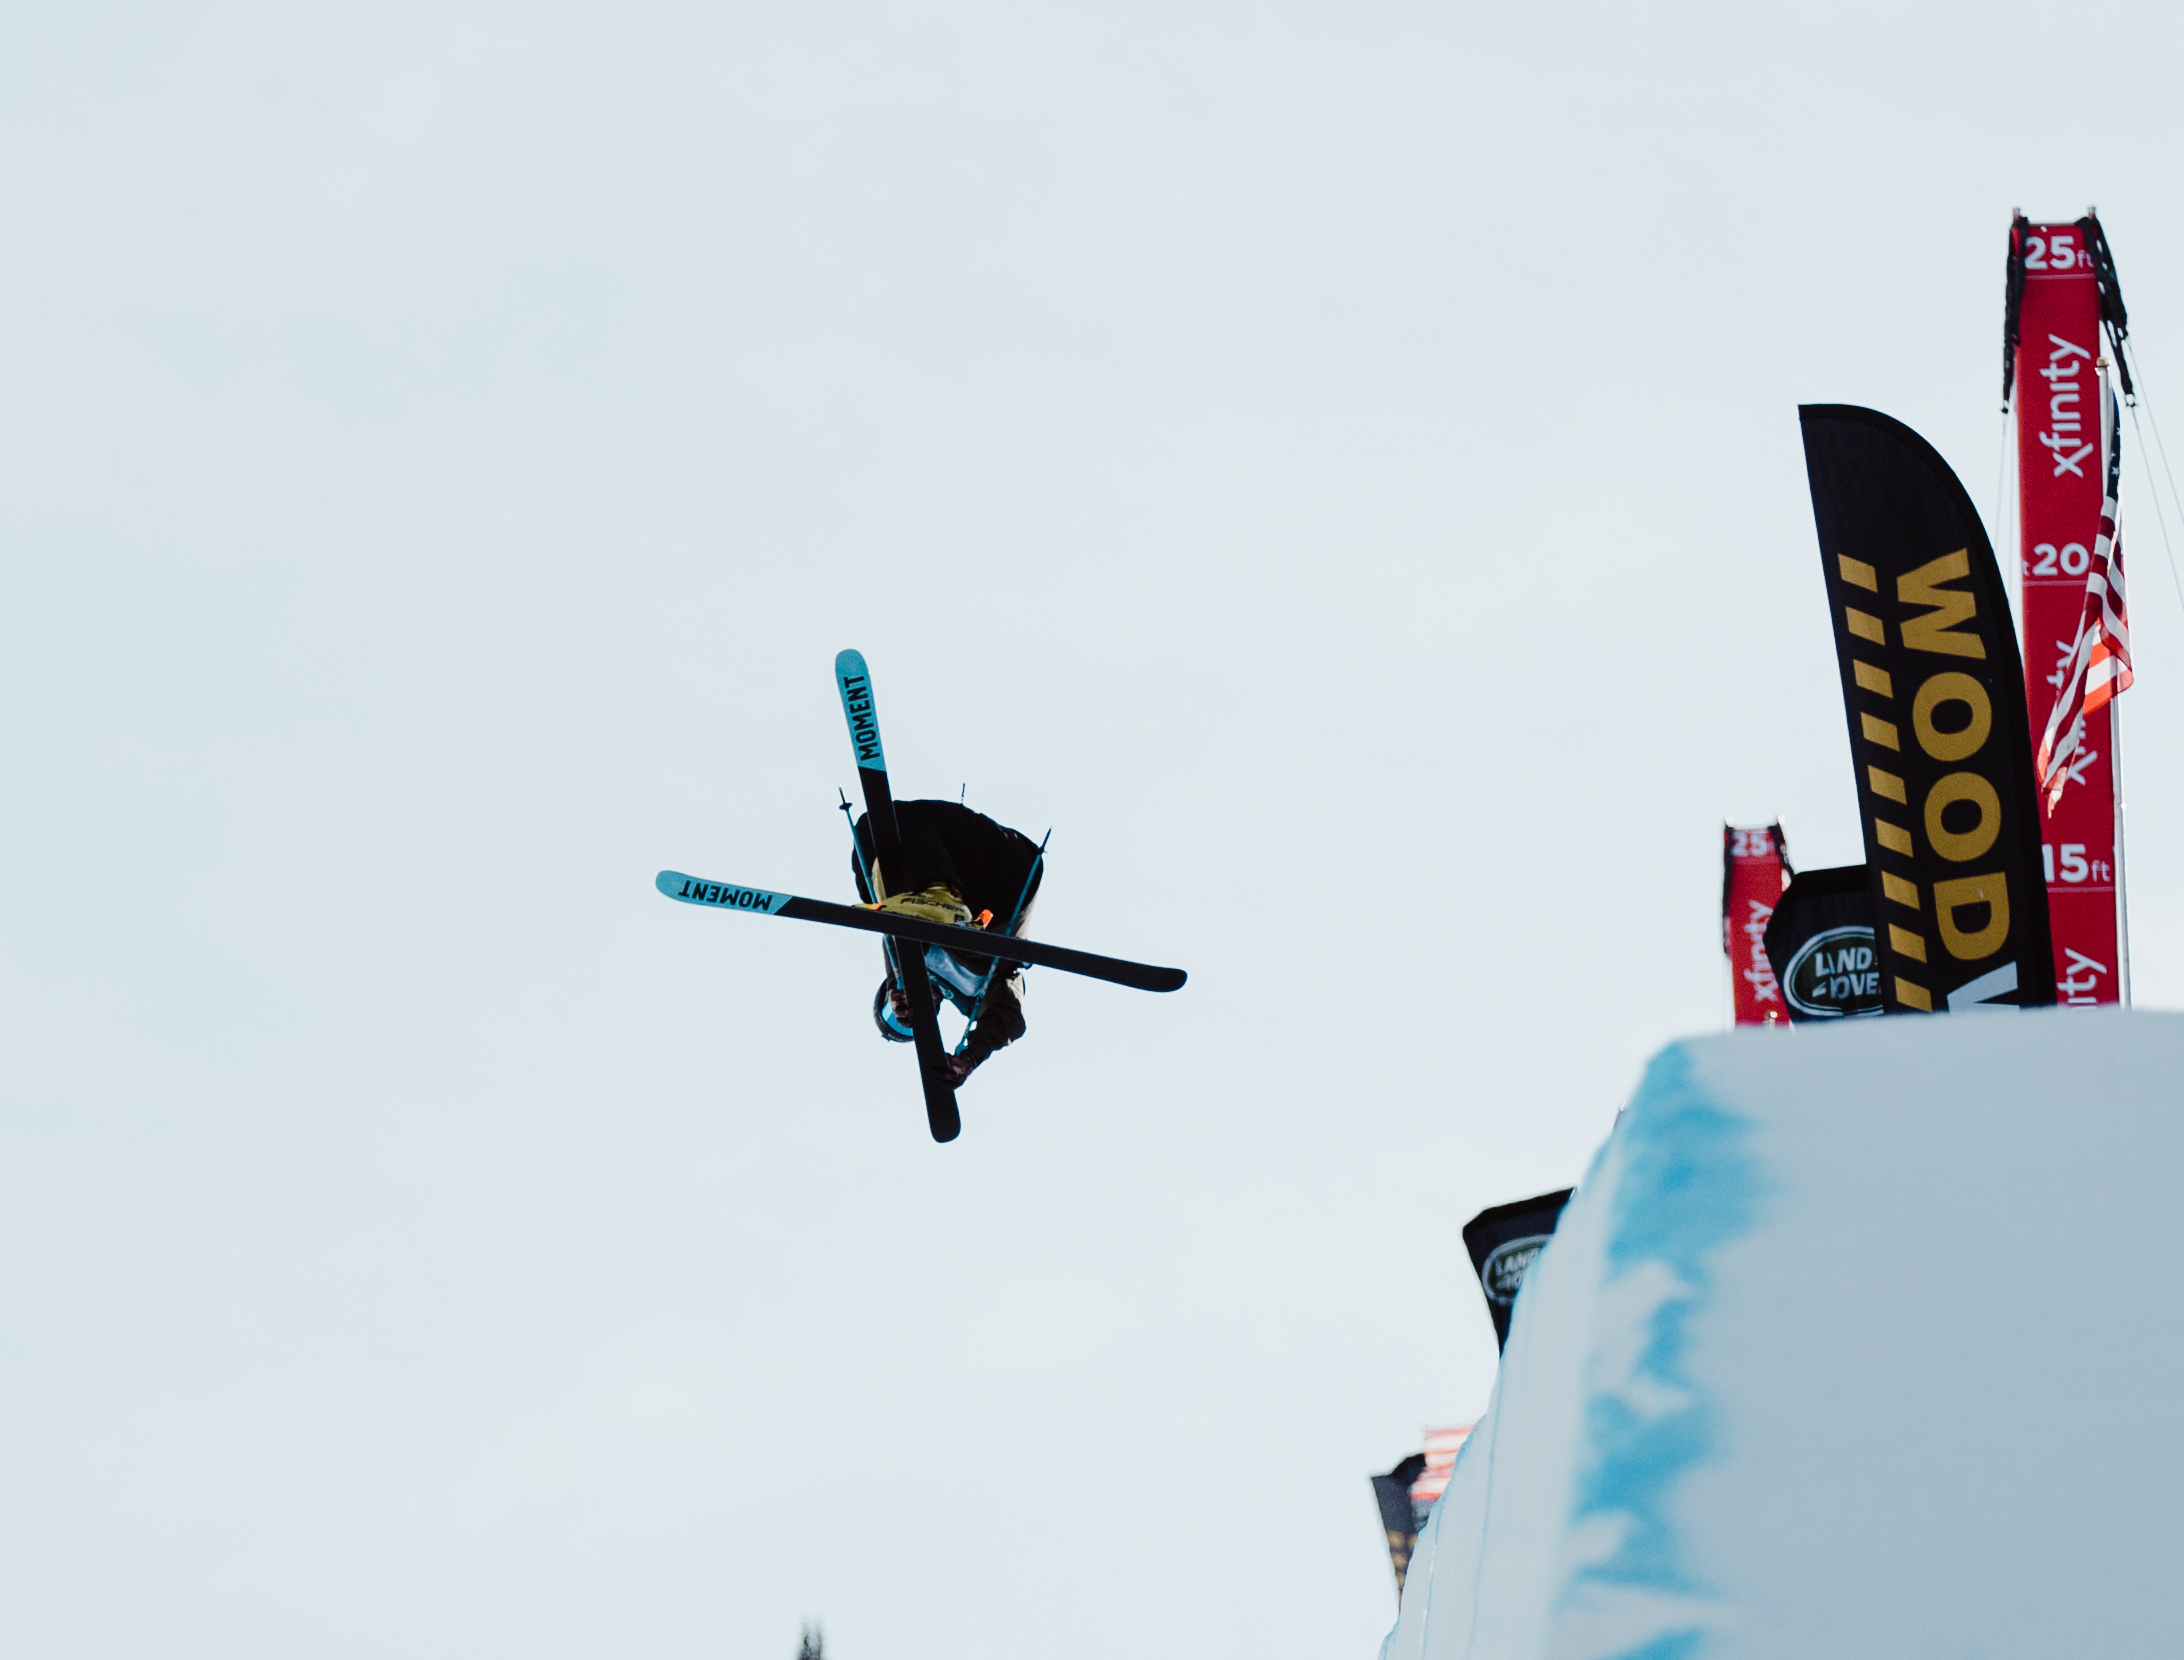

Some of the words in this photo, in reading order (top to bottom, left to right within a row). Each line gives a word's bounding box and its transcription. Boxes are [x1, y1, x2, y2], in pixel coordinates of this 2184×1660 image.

[2039, 333, 2093, 478] xfinity
[2032, 542, 2090, 576] 20
[843, 674, 880, 761] MOMENT
[677, 879, 774, 911] MOMENT
